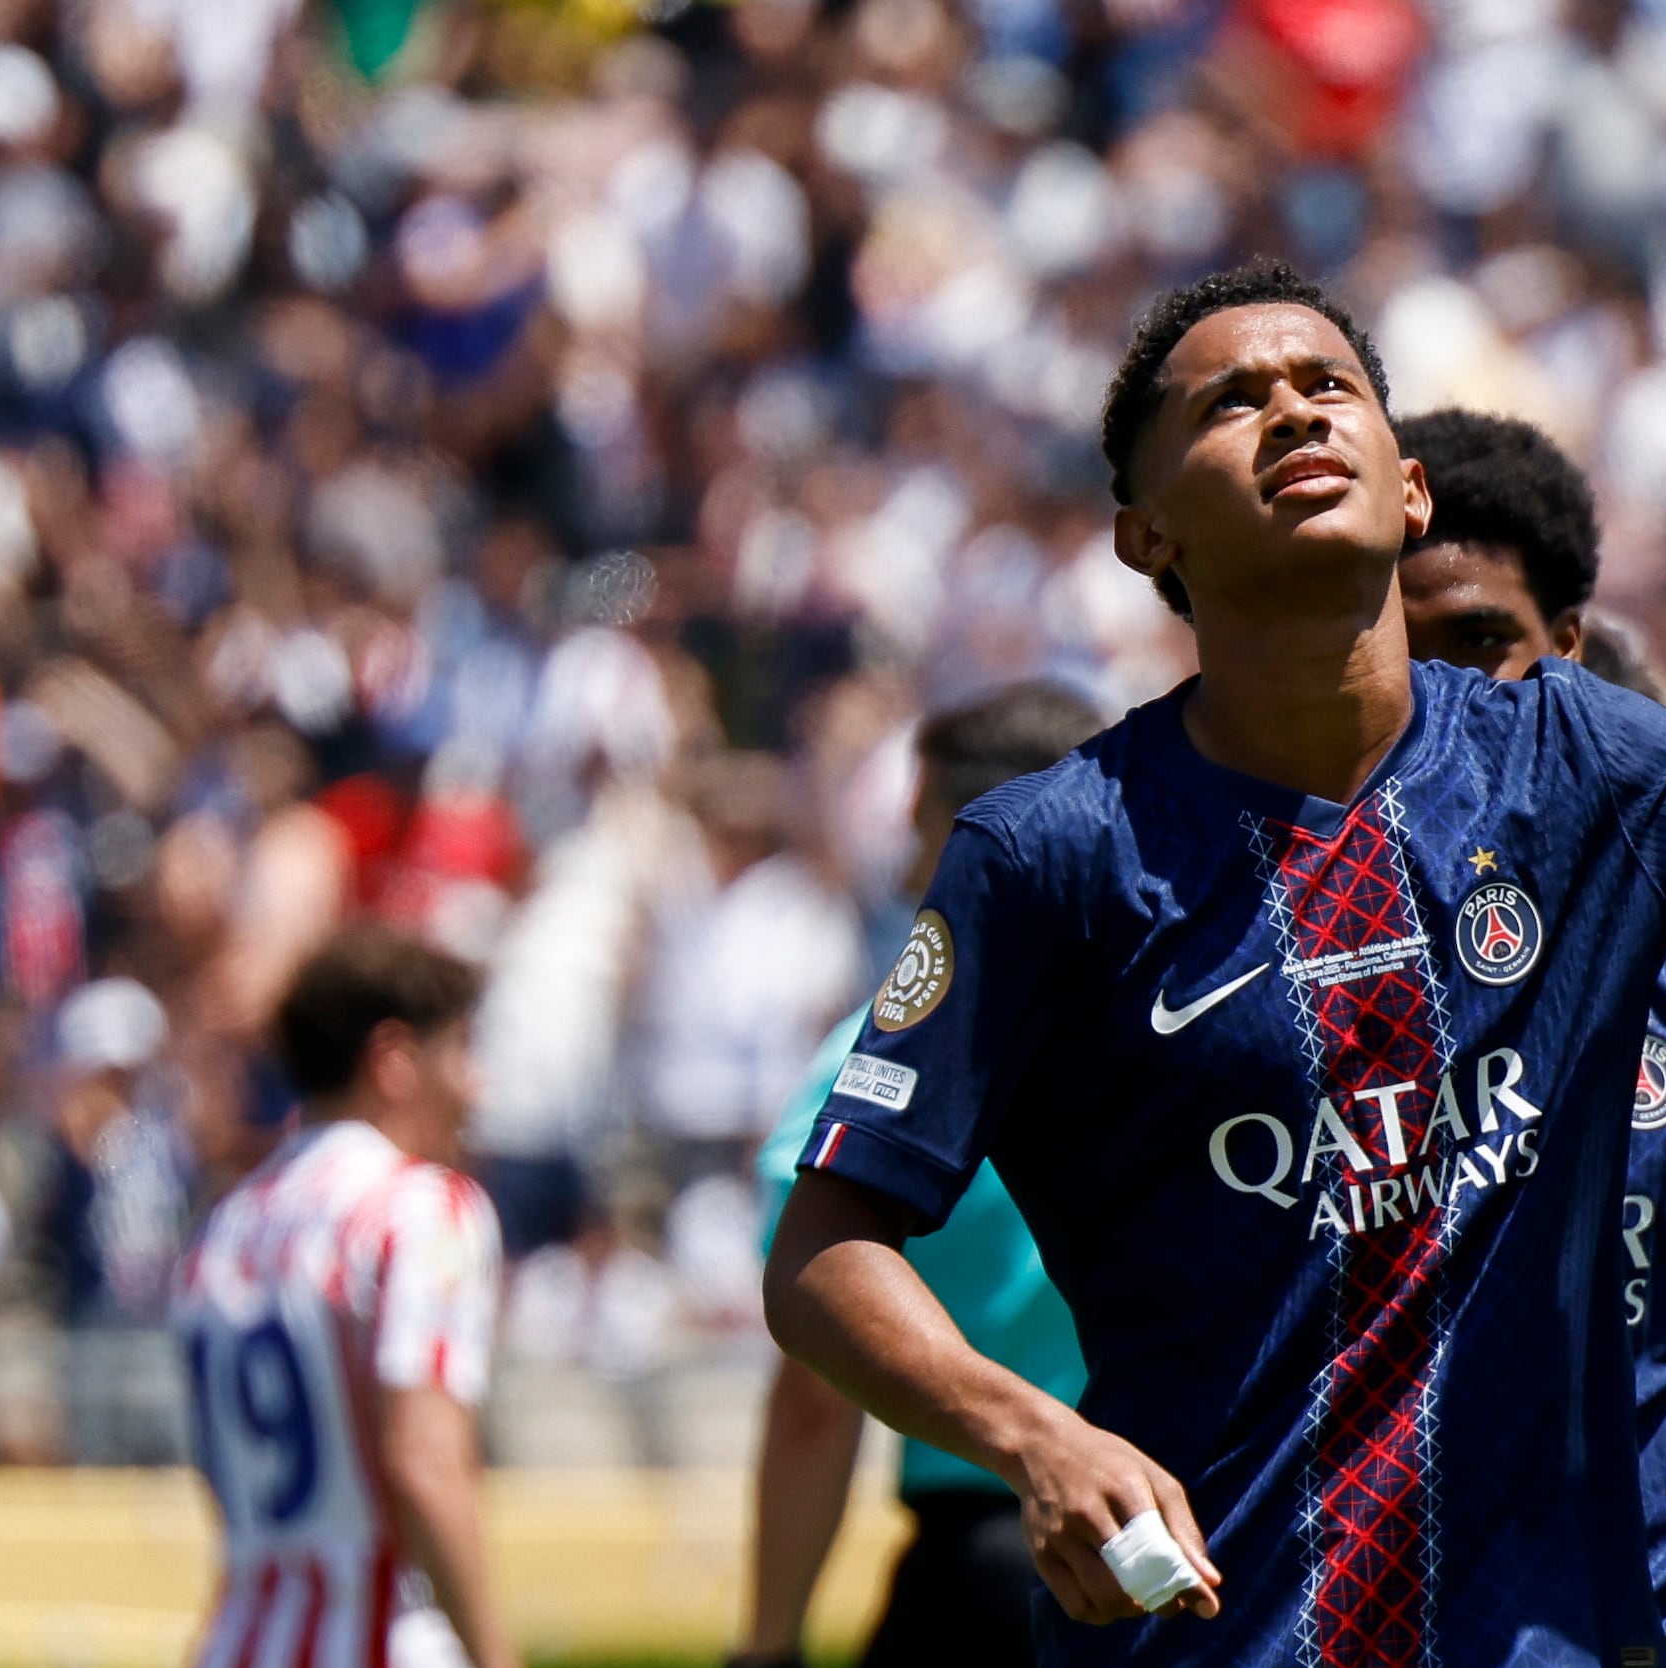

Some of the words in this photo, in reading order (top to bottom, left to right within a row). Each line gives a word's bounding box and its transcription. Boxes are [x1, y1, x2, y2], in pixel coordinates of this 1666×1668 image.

[1464, 887, 1518, 919] PARIS
[926, 926, 944, 951] CUP
[933, 956, 945, 976] 25
[1282, 962, 1304, 975] Paris
[1391, 940, 1402, 950] de
[1306, 968, 1324, 980] June
[1383, 947, 1420, 962] California
[1372, 960, 1405, 975] America
[913, 980, 939, 1009] USA
[878, 1000, 907, 1022] FIFA
[874, 1063, 906, 1084] UNITES
[874, 1083, 898, 1101] FIFA
[1208, 1046, 1543, 1210] QATAR
[1308, 1128, 1540, 1241] AIRWAYS
[188, 1313, 319, 1523] 19
